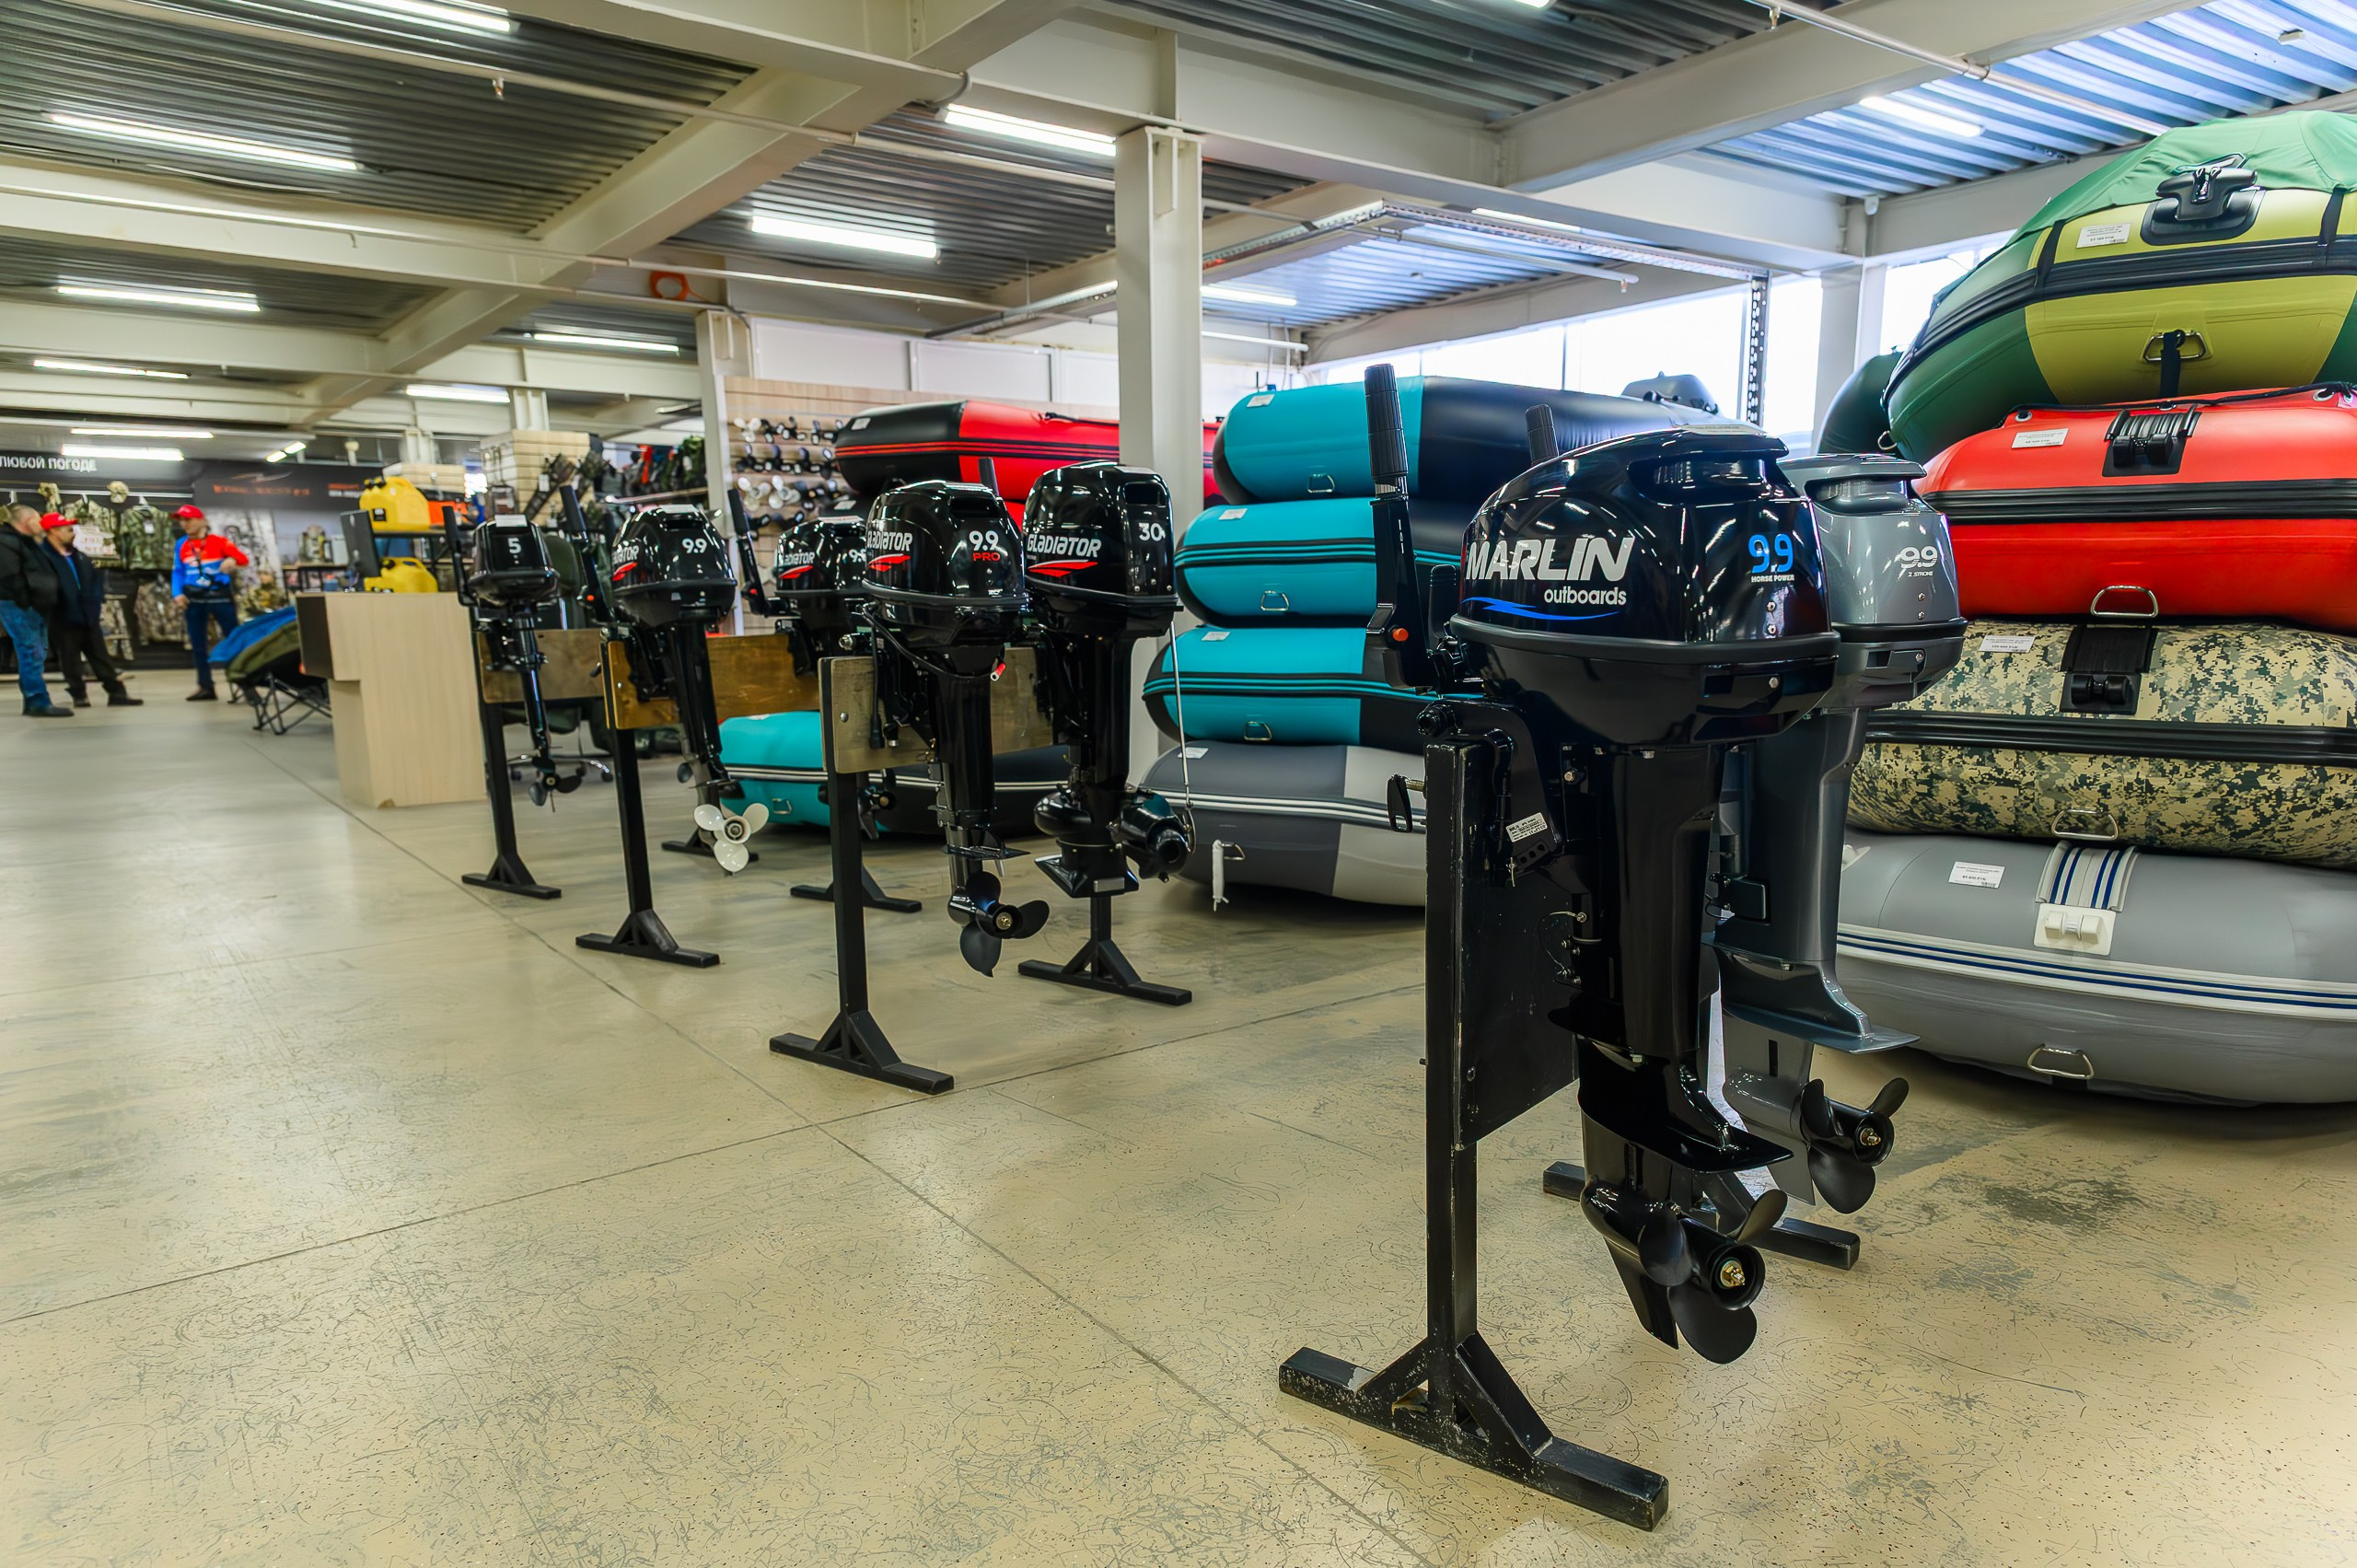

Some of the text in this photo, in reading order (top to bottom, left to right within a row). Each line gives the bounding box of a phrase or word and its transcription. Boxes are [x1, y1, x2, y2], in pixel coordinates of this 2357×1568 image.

[0, 456, 97, 472] ЛЮБОЙ ПОГОДЕ
[969, 530, 999, 551] 9.9
[1139, 523, 1162, 541] 30
[508, 537, 522, 553] 5
[682, 539, 707, 553] 9.9
[1028, 533, 1102, 558] GLADIATOR
[1748, 534, 1794, 573] 9.9
[972, 552, 1001, 562] PRO
[1466, 537, 1635, 582] MARLIN
[1899, 546, 1938, 569] 9.9
[1544, 586, 1627, 606] outboards
